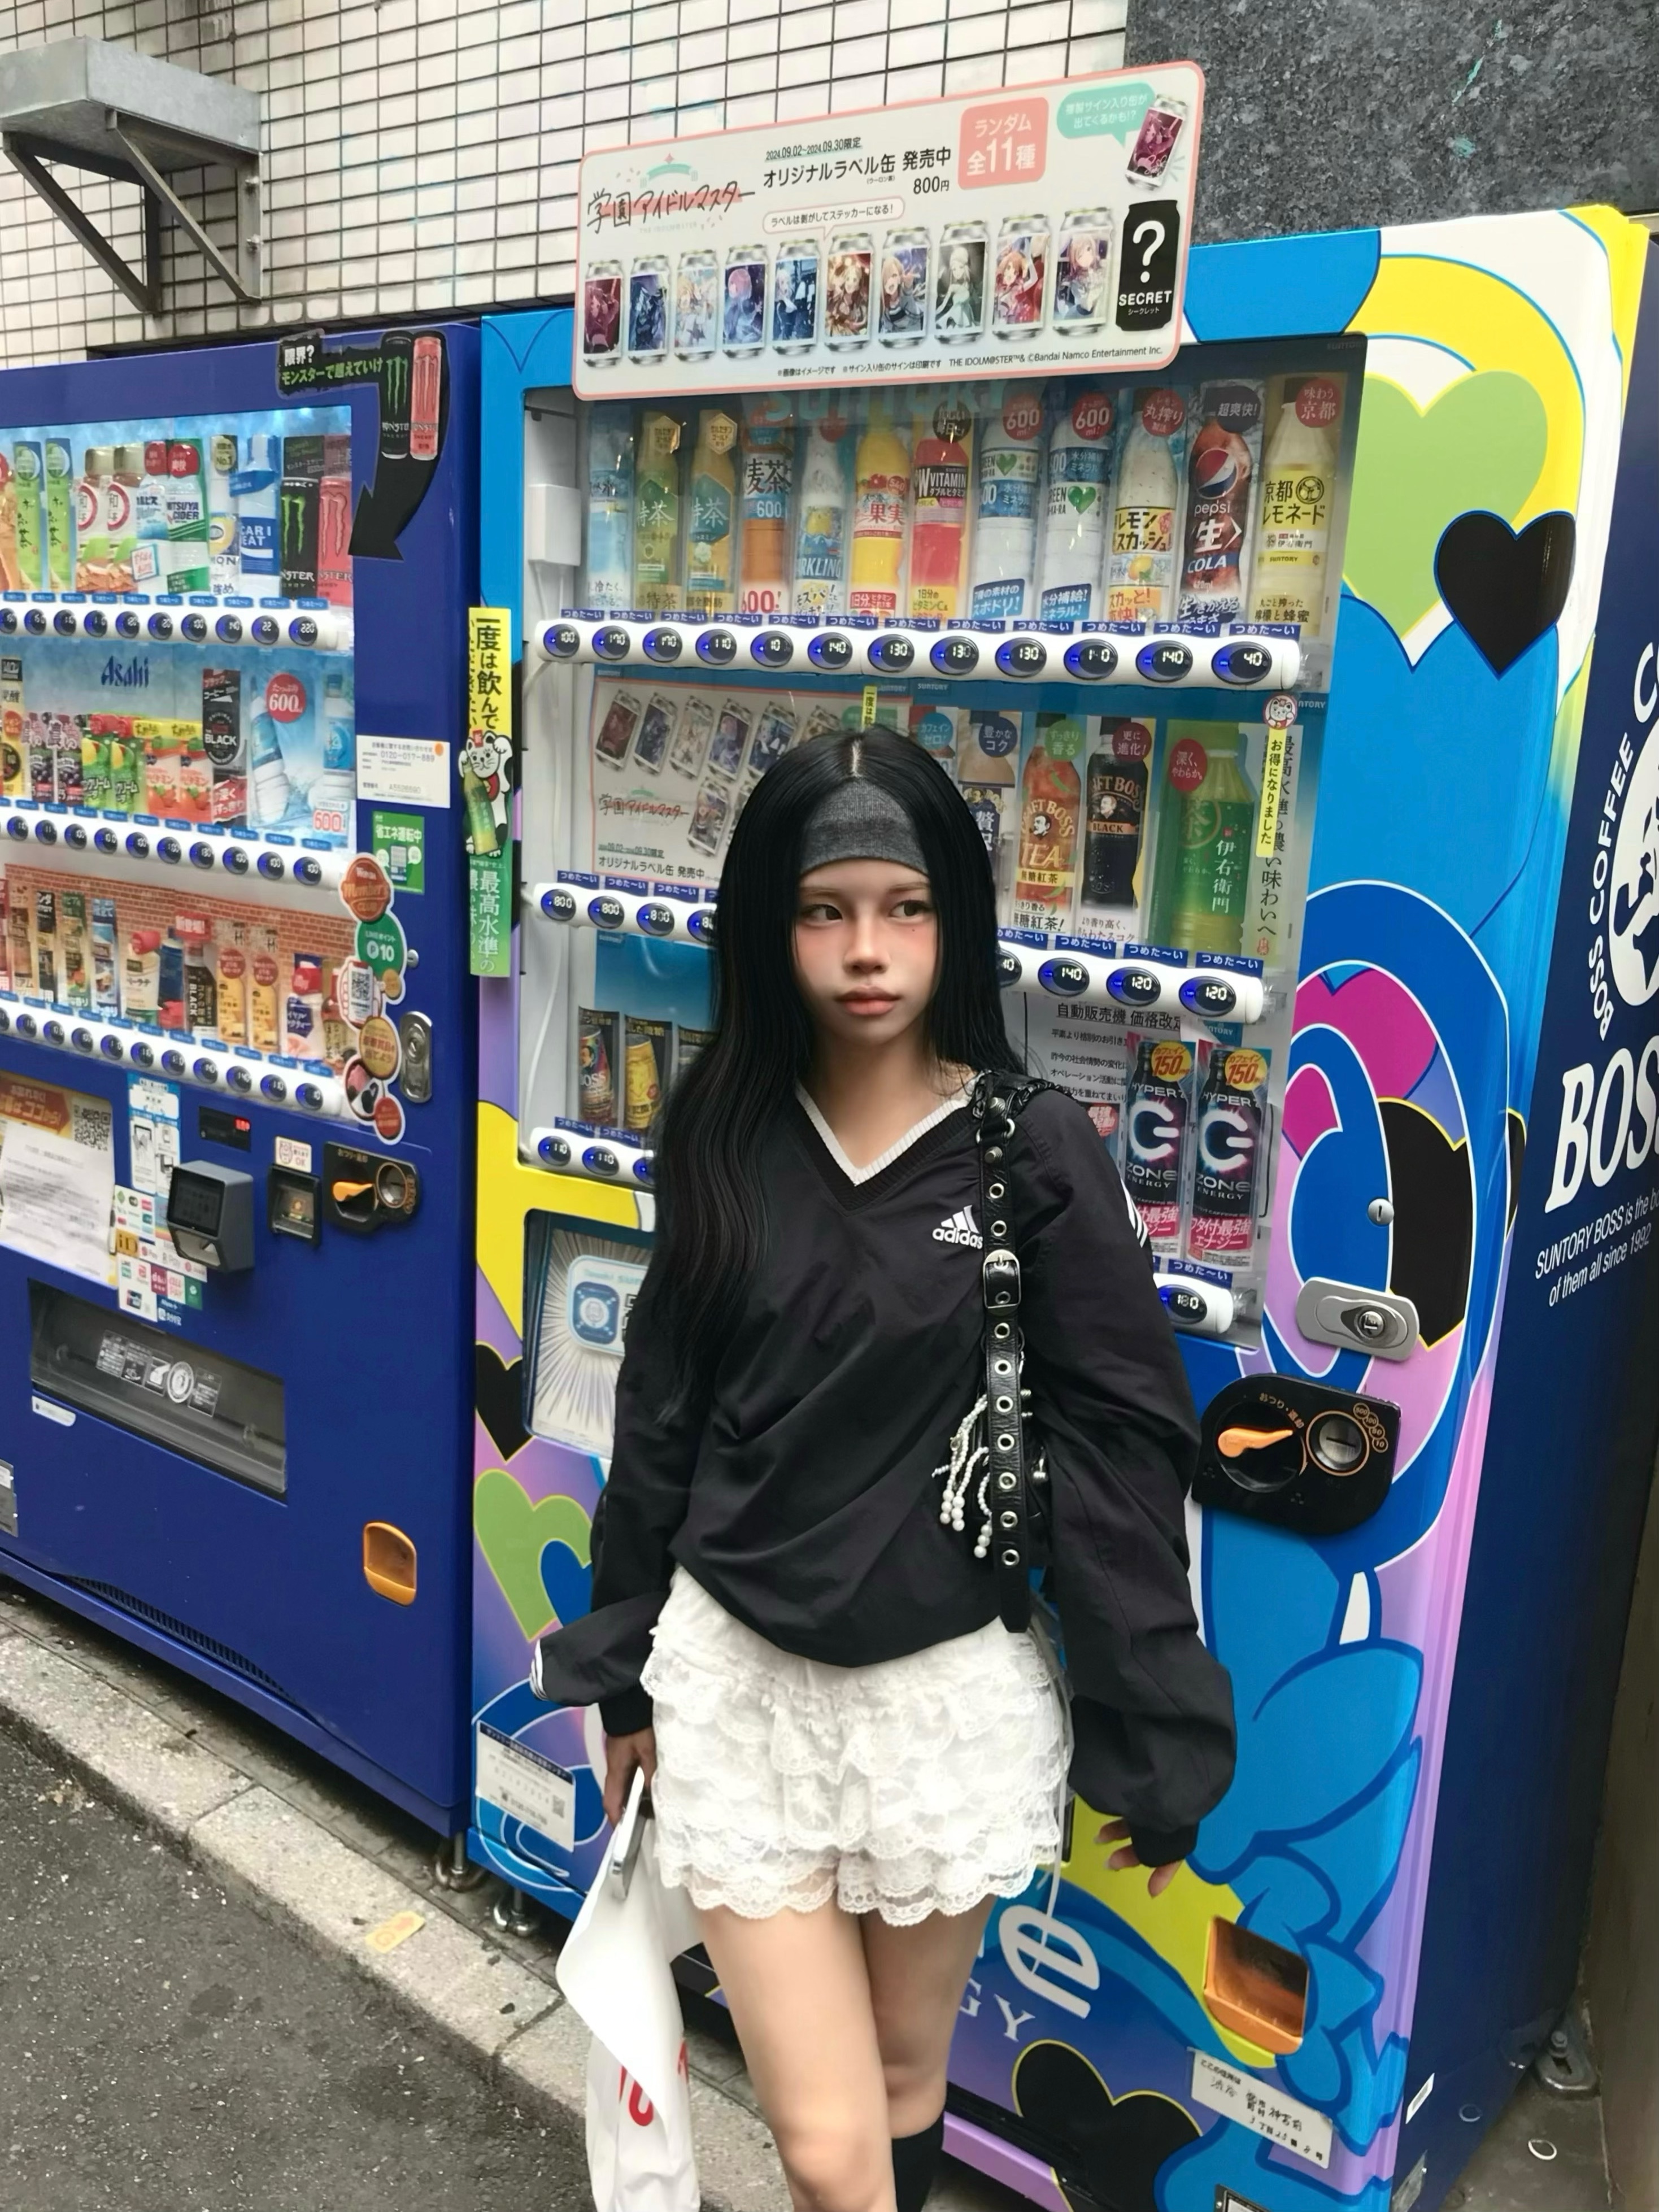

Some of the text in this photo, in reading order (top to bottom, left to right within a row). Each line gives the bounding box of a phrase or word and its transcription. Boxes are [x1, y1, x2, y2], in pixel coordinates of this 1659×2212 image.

[975, 114, 1032, 137] ランダム
[966, 138, 1036, 176] 全11種
[763, 146, 951, 188] オリジナルラベル缶 発売中
[913, 176, 950, 194] 800円
[587, 180, 756, 234] 学園アイドルマスター
[770, 204, 894, 228] ラベルは剥がしてステッカーになる!
[1132, 219, 1166, 284] ?
[1118, 290, 1172, 307] SECRET
[1127, 307, 1160, 315] シークレット
[284, 345, 314, 367] 限界?
[949, 358, 963, 367] THE
[1062, 350, 1090, 360] Namco
[1091, 347, 1146, 359] Entertainment
[1148, 346, 1163, 356] Inc.
[281, 357, 382, 386] モンスターで超えていけ
[1304, 387, 1334, 399] 味わう
[1075, 407, 1110, 426] 600
[1144, 404, 1183, 419] 丸搾り
[1217, 402, 1258, 417] 超爽快!
[1301, 402, 1336, 420] 京都
[1006, 410, 1040, 429] 600
[746, 458, 793, 495] 麦茶
[918, 468, 931, 498] W
[930, 472, 966, 487] VITAMIN
[1265, 480, 1293, 503] 京都
[173, 511, 199, 520] CIDER
[756, 500, 782, 517] 600
[870, 502, 904, 525] 果実
[1194, 501, 1231, 516] pepsi
[1117, 531, 1166, 551] スカッシュ
[1194, 518, 1225, 553] 生
[1188, 554, 1227, 574] COLA
[973, 597, 1019, 617] スポドリ!
[1042, 589, 1088, 607] 水分補給!
[1109, 587, 1151, 608] スカッと!
[1260, 598, 1304, 608] 丸ごと搾った
[889, 644, 907, 656] 130
[1019, 647, 1038, 660] 130
[1161, 651, 1184, 664] 140
[101, 655, 150, 688] Asahi
[476, 618, 503, 730] 一度は飲んで
[920, 723, 950, 733] カフェイン
[983, 727, 1012, 739] 豊かな
[1123, 730, 1140, 741] 更に
[205, 734, 237, 746] BLACK
[986, 739, 1009, 752] コク
[1117, 742, 1147, 756] 進化!
[1052, 744, 1076, 756] 香る
[1260, 739, 1283, 844] お得になりました
[1047, 800, 1075, 839] BOSS
[1092, 822, 1124, 834] BLACK
[376, 824, 423, 842] 省エネ運転中
[1021, 843, 1063, 869] TEA
[598, 856, 705, 879] オリジナルラベル缶 発売中
[1212, 839, 1237, 914] 伊右衛門
[1589, 732, 1634, 1041] BOSS COFFEE
[554, 896, 572, 908] 800
[602, 903, 619, 915] 800
[478, 870, 500, 973] 最高水準の
[380, 943, 395, 962] 10
[1061, 967, 1082, 981] 140
[1131, 976, 1152, 991] 120
[1205, 986, 1227, 1001] 120
[1057, 1003, 1126, 1025] 自動販売機
[1228, 1054, 1262, 1064] カフェイン
[1132, 1083, 1177, 1098] HYPER
[1203, 1091, 1252, 1107] HYPER
[1544, 1035, 1659, 1213] BOS
[1126, 1163, 1177, 1181] ZONE
[1195, 1173, 1251, 1192] ZONE
[119, 1234, 138, 1253] iD
[932, 1227, 983, 1250] adidas
[1195, 1236, 1244, 1249] エナジー
[1535, 1220, 1595, 1280] SUNTORY
[1594, 1205, 1624, 1244] BOSS
[1625, 1201, 1633, 1223] is
[1634, 1194, 1649, 1219] the
[1549, 1222, 1652, 1307] of them all since 1992
